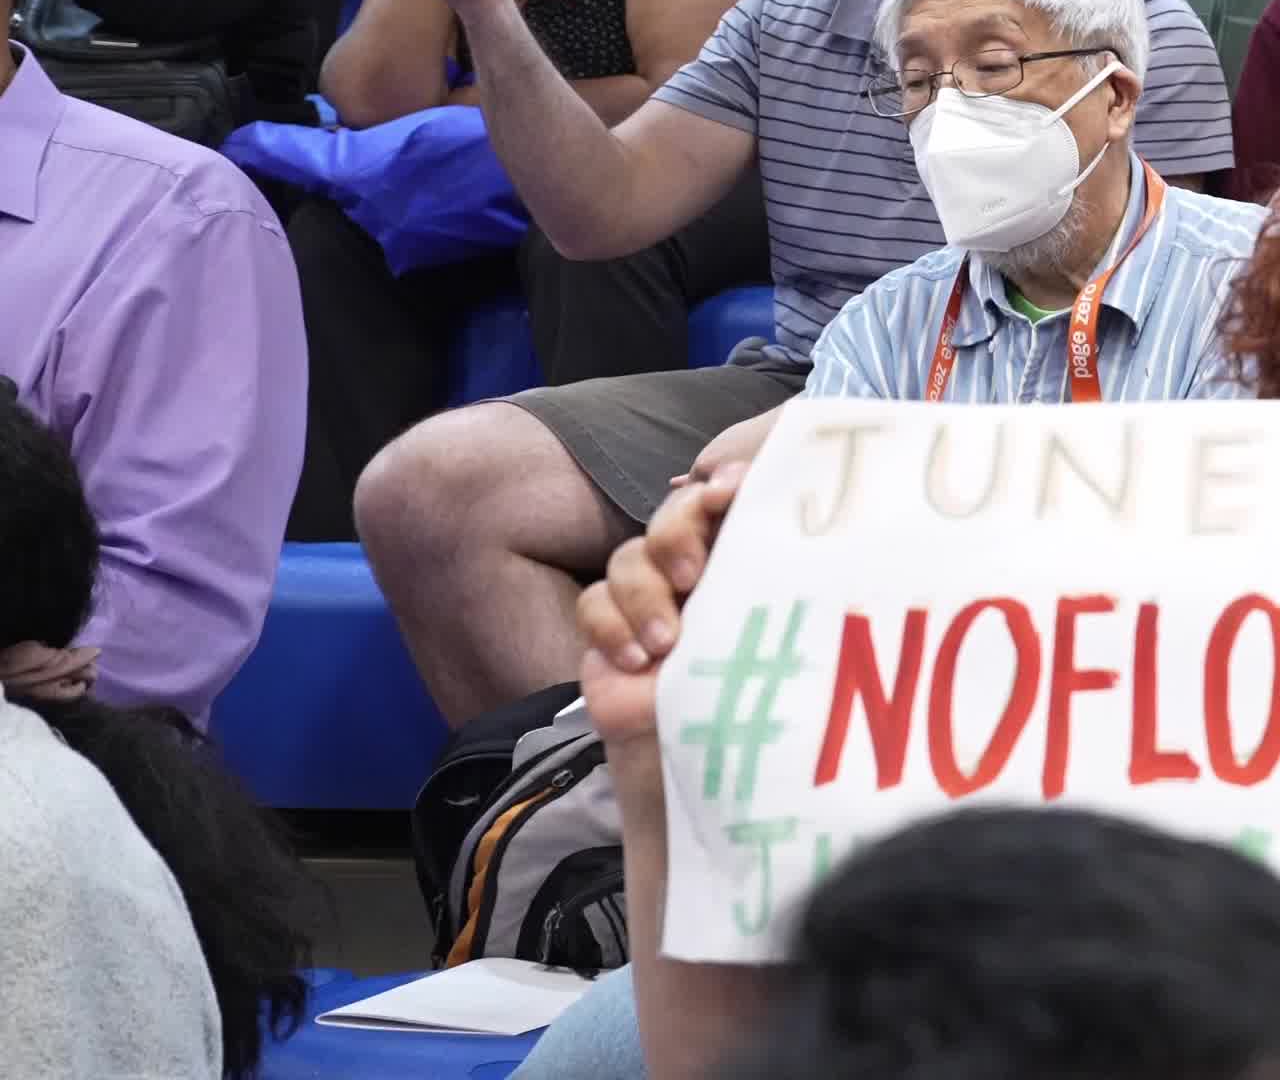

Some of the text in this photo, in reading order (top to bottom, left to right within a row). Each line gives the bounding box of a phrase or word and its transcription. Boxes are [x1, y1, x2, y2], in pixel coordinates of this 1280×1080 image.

[1071, 283, 1097, 378] page zero
[798, 420, 1260, 537] JUNE
